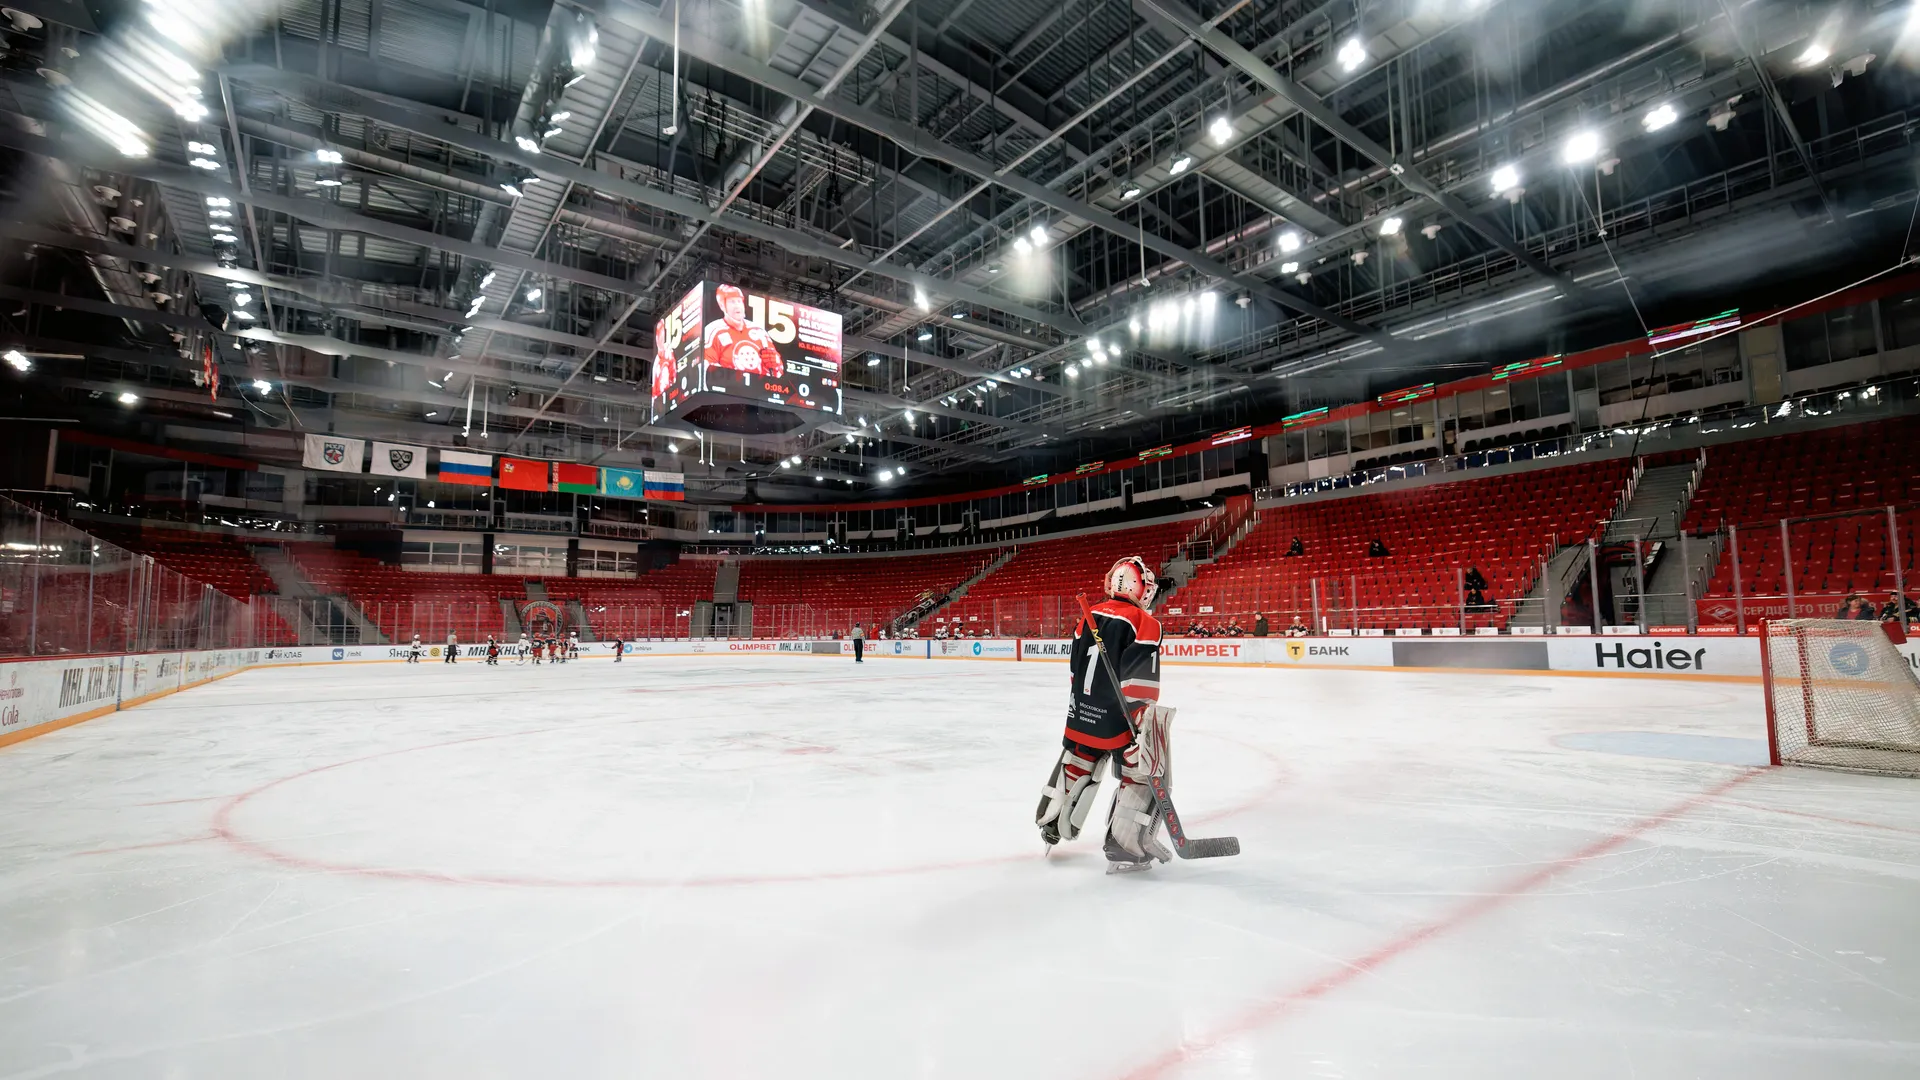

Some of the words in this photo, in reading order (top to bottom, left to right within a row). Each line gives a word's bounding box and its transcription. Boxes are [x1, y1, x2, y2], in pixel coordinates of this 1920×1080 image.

[748, 294, 797, 344] 15
[664, 304, 683, 350] 15
[742, 372, 751, 386] 1
[764, 382, 790, 394] 0:08.4
[798, 383, 810, 397] 0
[1743, 604, 1789, 616] СЕРДЦЕ
[1794, 603, 1815, 614] ЕГО
[388, 648, 428, 658] Яндс
[729, 643, 777, 651] OLIMPBET
[778, 642, 811, 652] MHL.KHL.RU
[1023, 643, 1072, 655] MHL.KHL.RU
[1309, 646, 1350, 656] БАНК
[1150, 650, 1157, 674] 1
[1595, 641, 1706, 670] Haier
[1082, 643, 1100, 696] 1
[58, 664, 119, 708] MHL.KHL.RU
[2, 704, 19, 727] Cola
